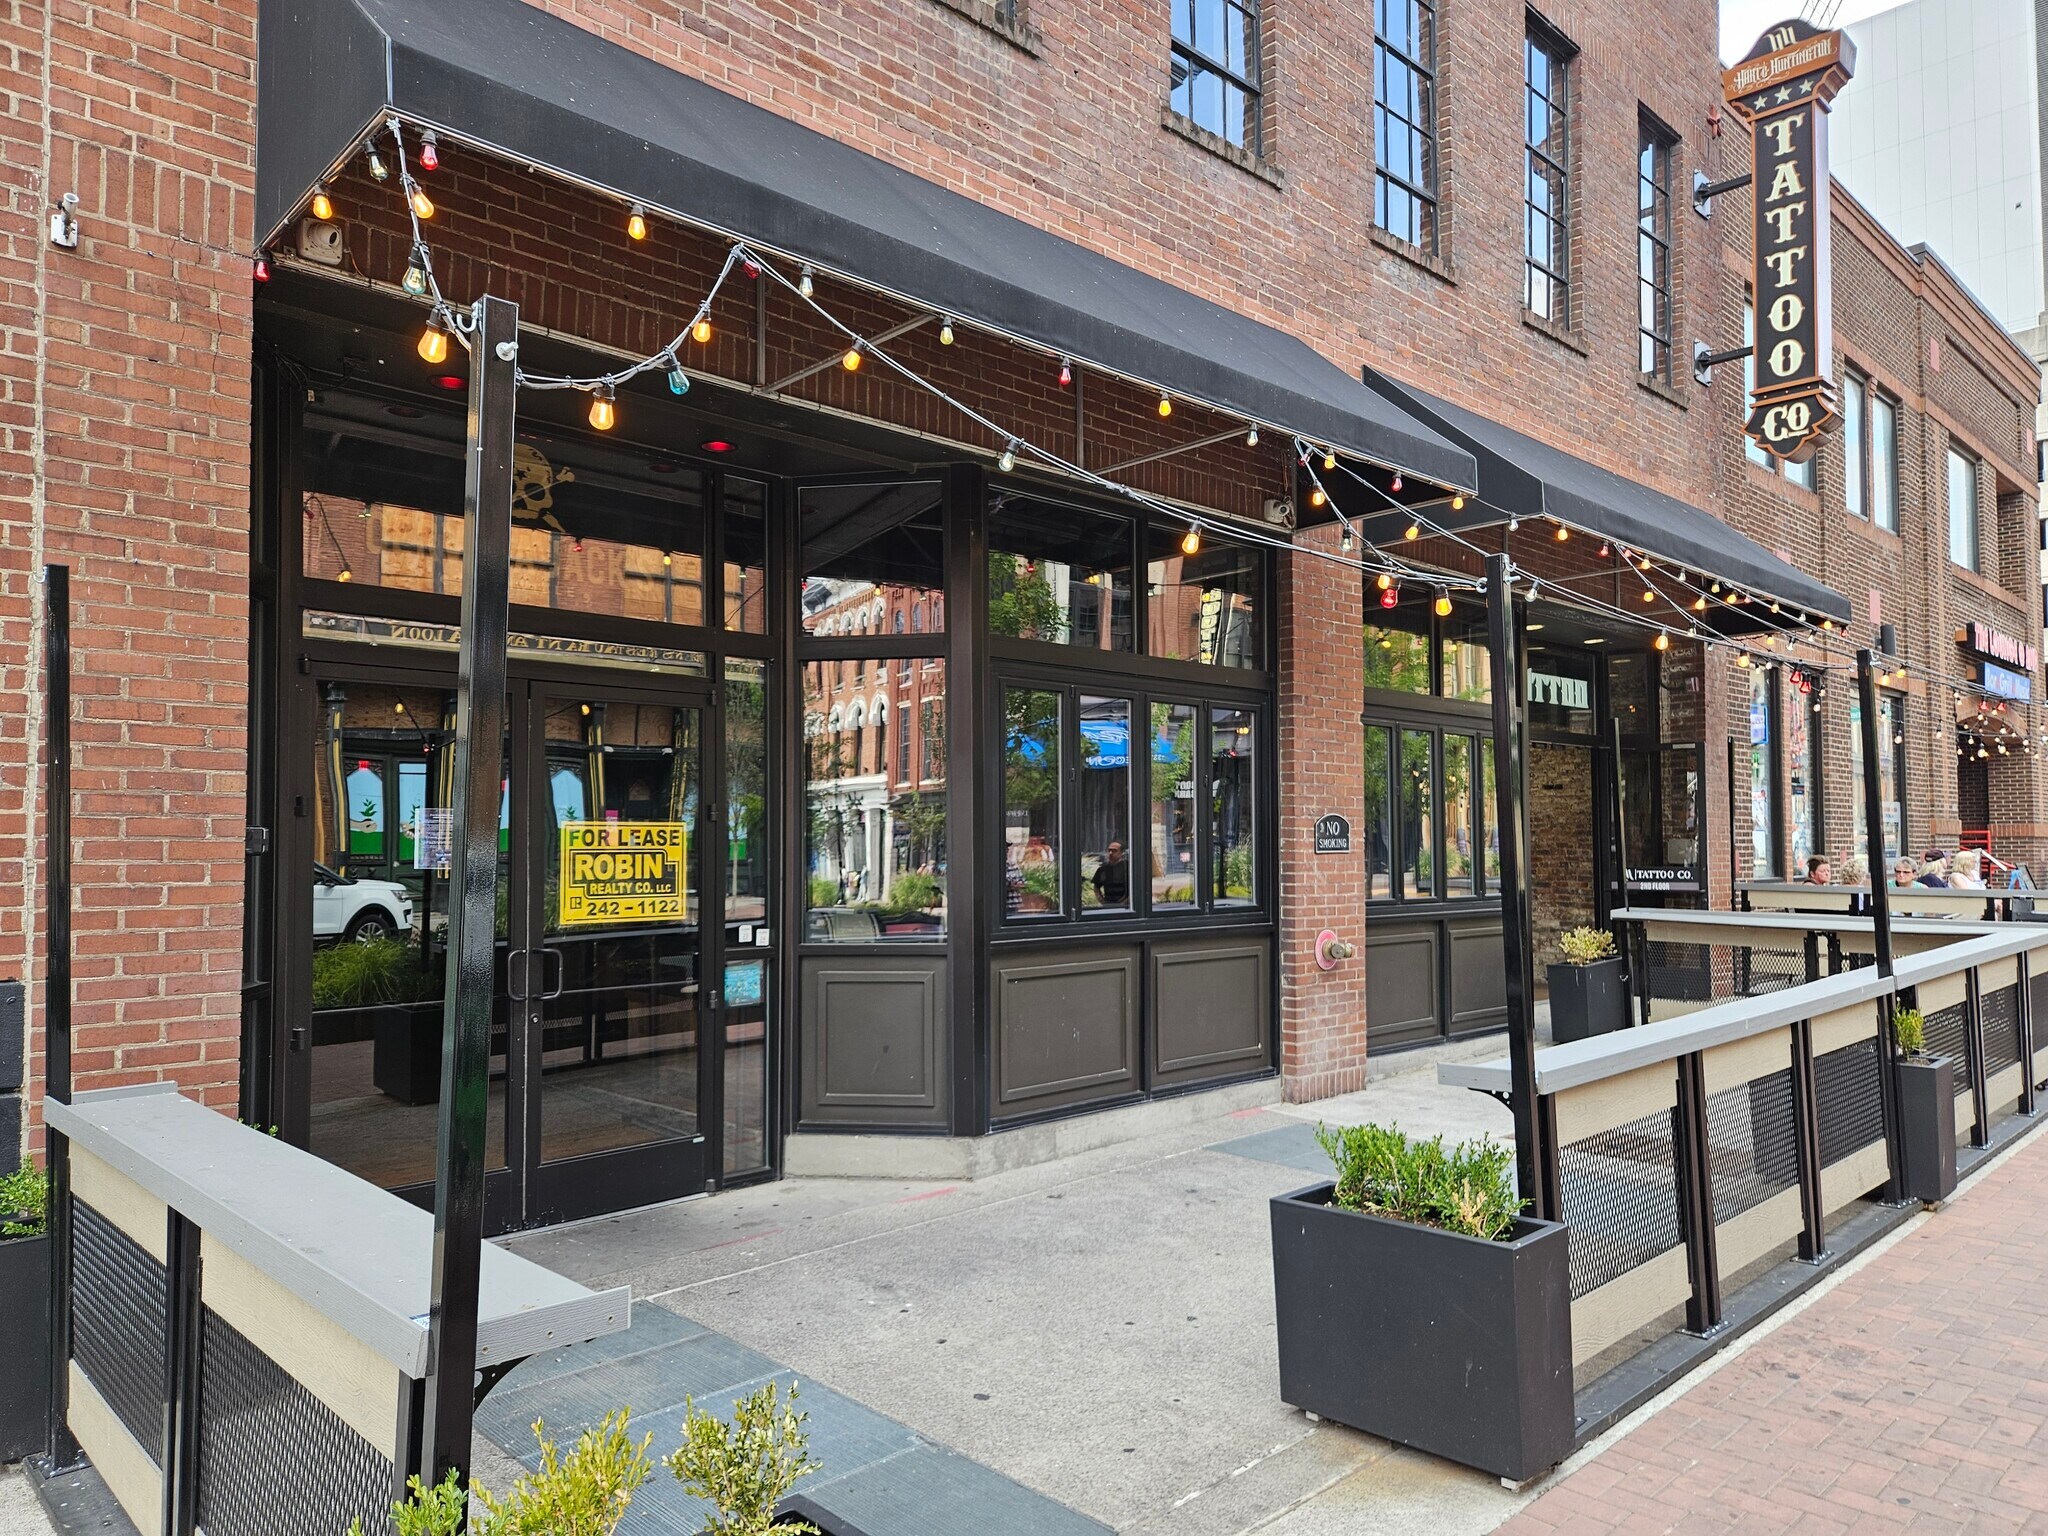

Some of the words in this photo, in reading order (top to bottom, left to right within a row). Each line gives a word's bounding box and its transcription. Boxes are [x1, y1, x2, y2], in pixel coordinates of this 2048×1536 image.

[1763, 112, 1807, 379] TATTOO
[1761, 402, 1812, 442] CO
[1326, 821, 1340, 836] NO
[569, 829, 610, 847] FOR
[618, 829, 680, 847] LEASE
[1319, 838, 1347, 849] SMOKING
[575, 853, 663, 881] ROBIN
[1636, 869, 1674, 880] TATTOO
[1677, 870, 1694, 880] CO.
[589, 882, 633, 895] REALTY
[635, 882, 654, 894] CO.
[656, 884, 671, 893] LLC
[1640, 882, 1652, 891] 2ND
[1652, 882, 1670, 891] FLOOR
